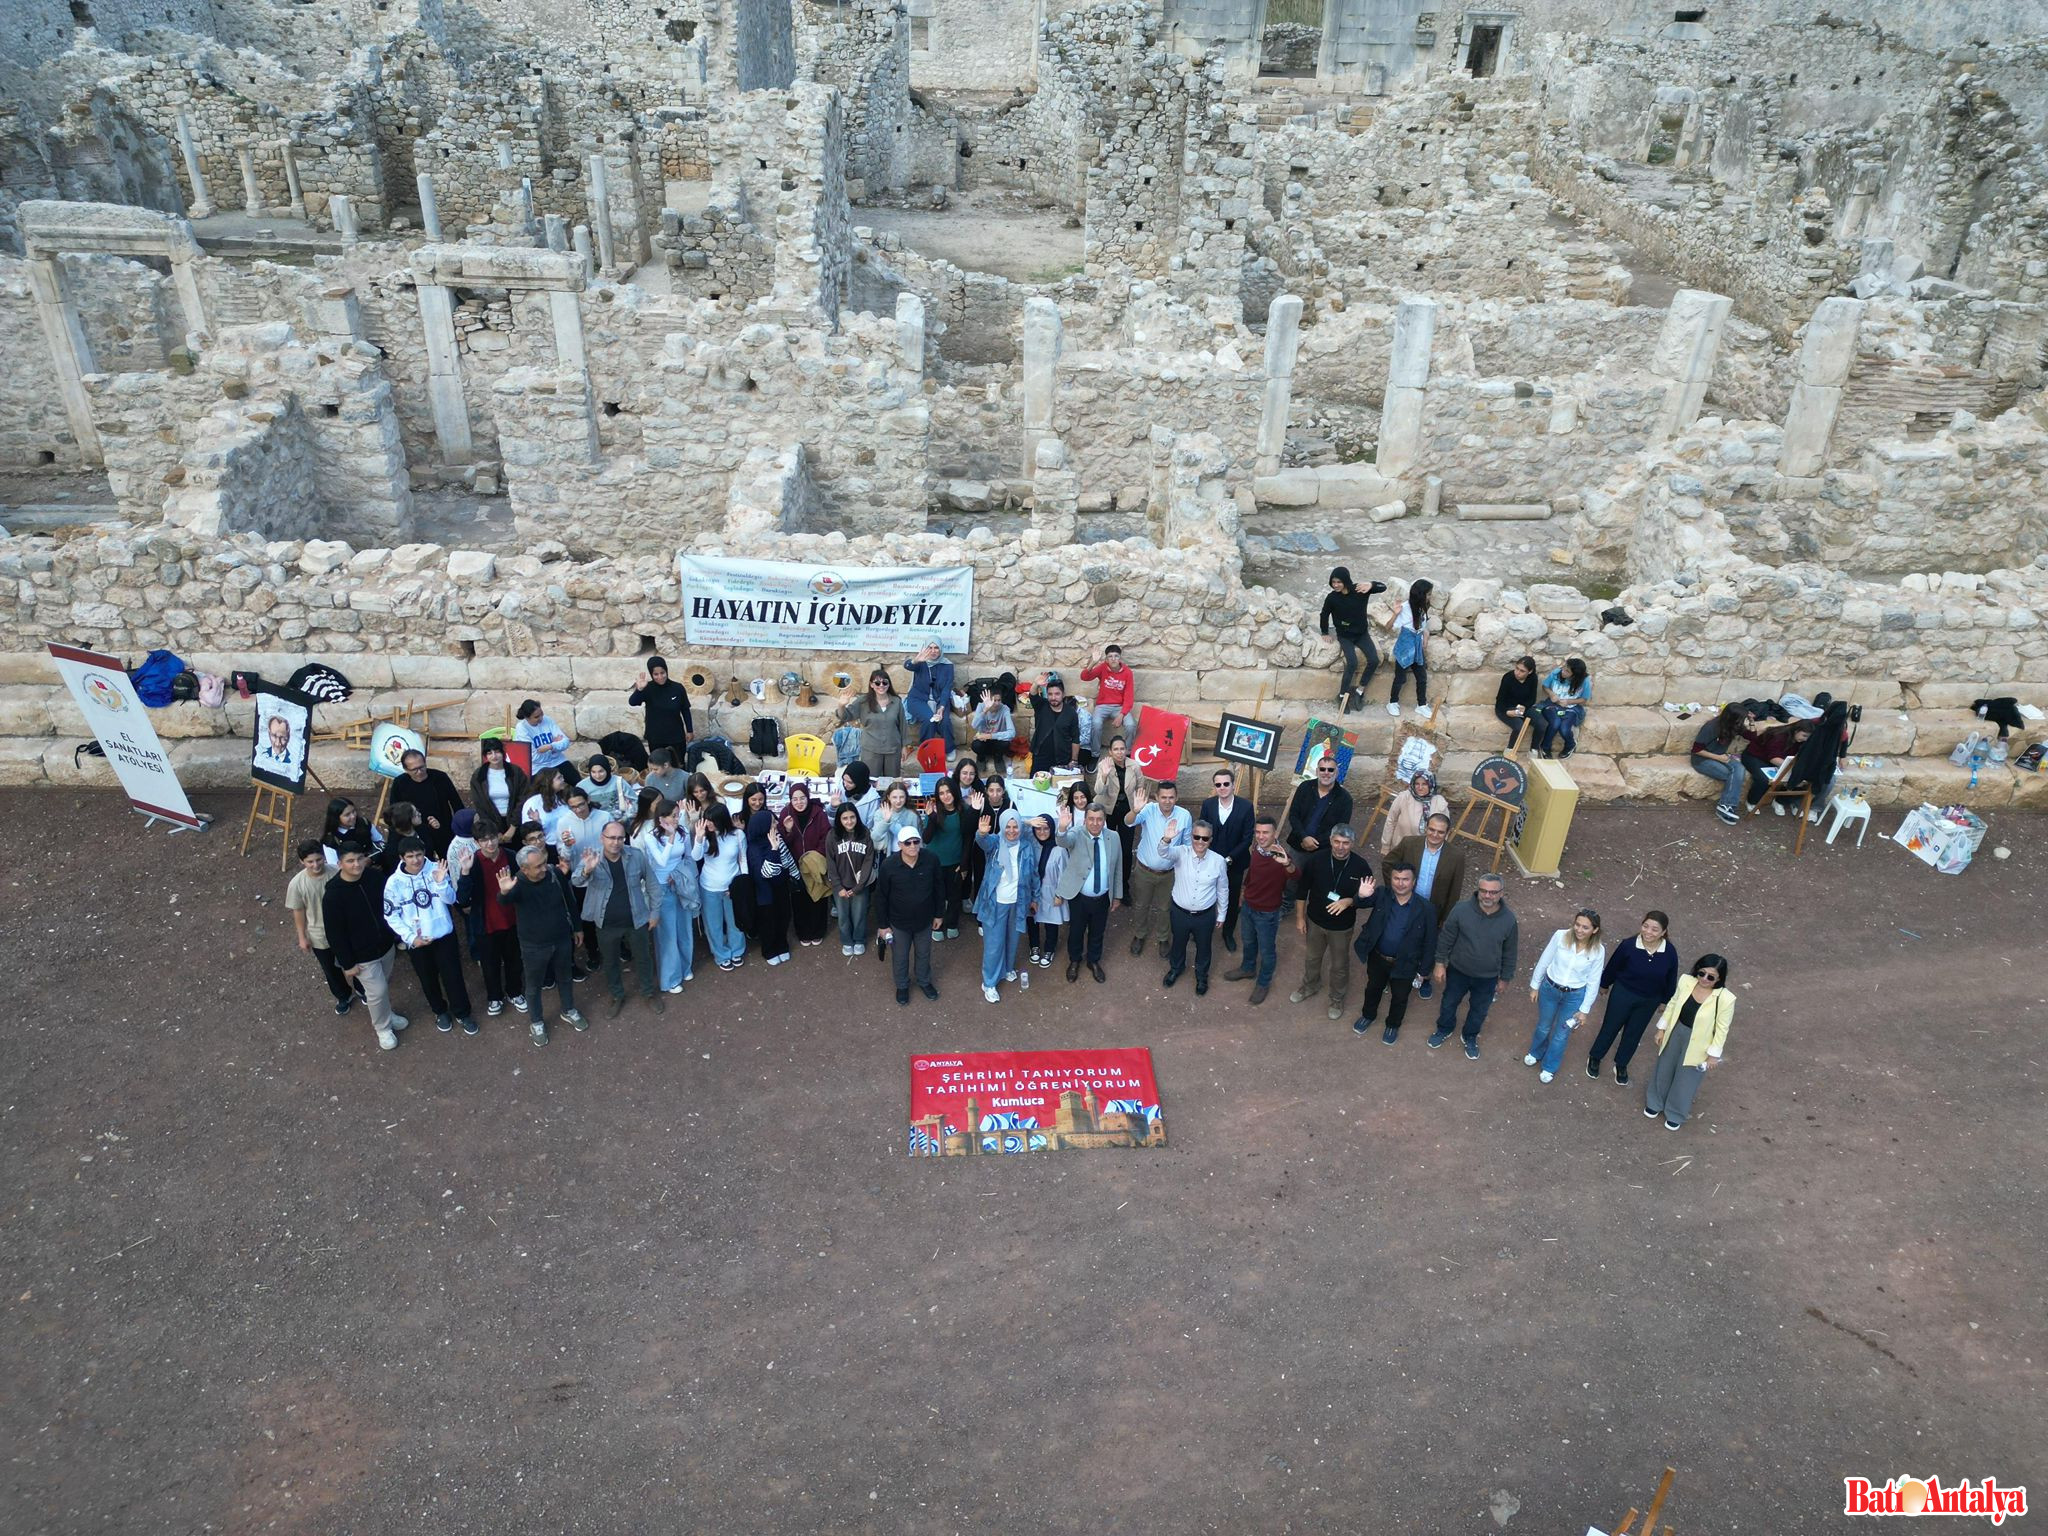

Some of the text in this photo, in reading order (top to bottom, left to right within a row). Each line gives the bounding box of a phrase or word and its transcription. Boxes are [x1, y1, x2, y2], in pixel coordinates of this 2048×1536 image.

[691, 596, 965, 631] HAYATIN İÇİNDEYİZ...
[120, 732, 135, 743] EL
[105, 740, 163, 762] SANATLARI
[118, 754, 165, 774] ATÖLYESİ
[851, 841, 867, 855] YORK
[942, 1067, 1122, 1083] ŞEHRİMİ TANIYORUM
[925, 1079, 1141, 1094] TARİHİMİ ÖĞRENİYORUM
[992, 1096, 1045, 1107] Kumluca
